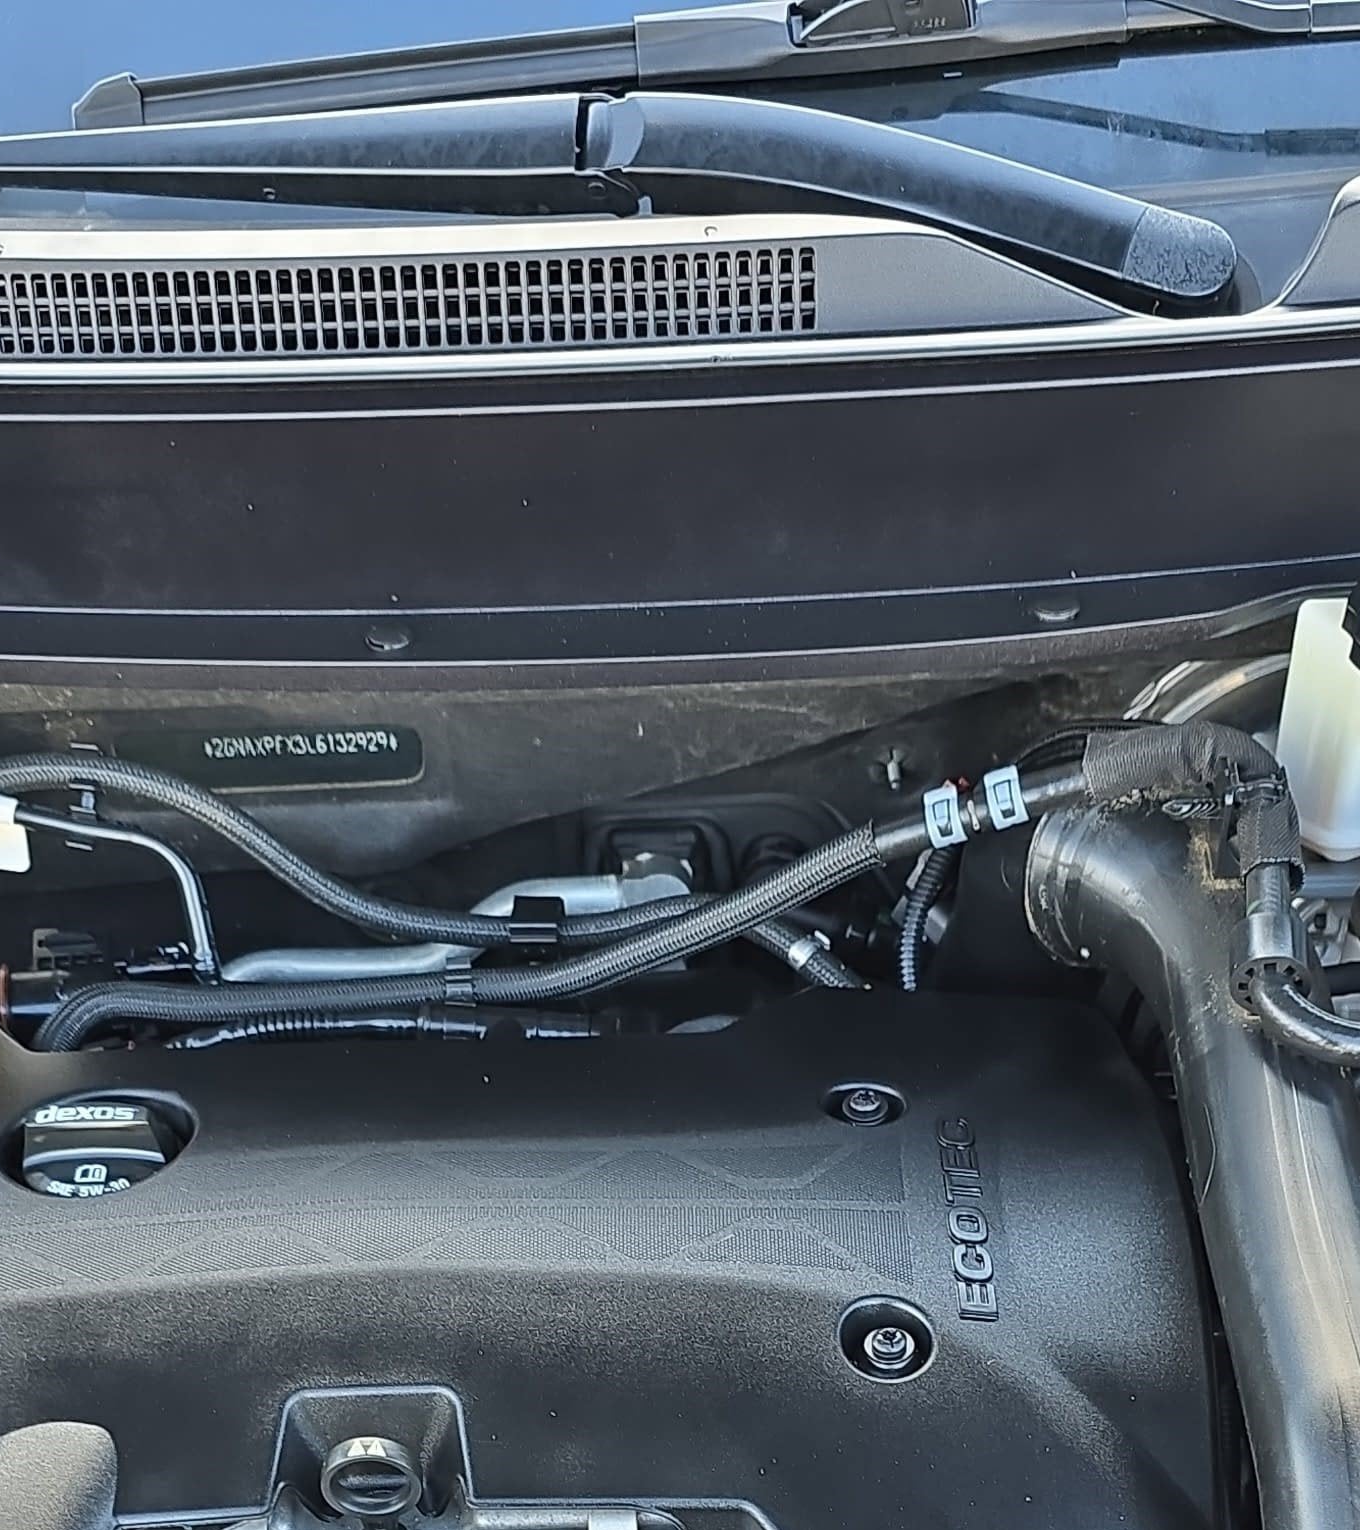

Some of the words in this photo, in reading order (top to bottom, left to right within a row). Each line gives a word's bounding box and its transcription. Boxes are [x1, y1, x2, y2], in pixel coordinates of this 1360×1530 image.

[35, 1105, 135, 1124] dexos
[46, 1181, 76, 1197] SAE
[937, 1117, 999, 1322] ECOTEC
